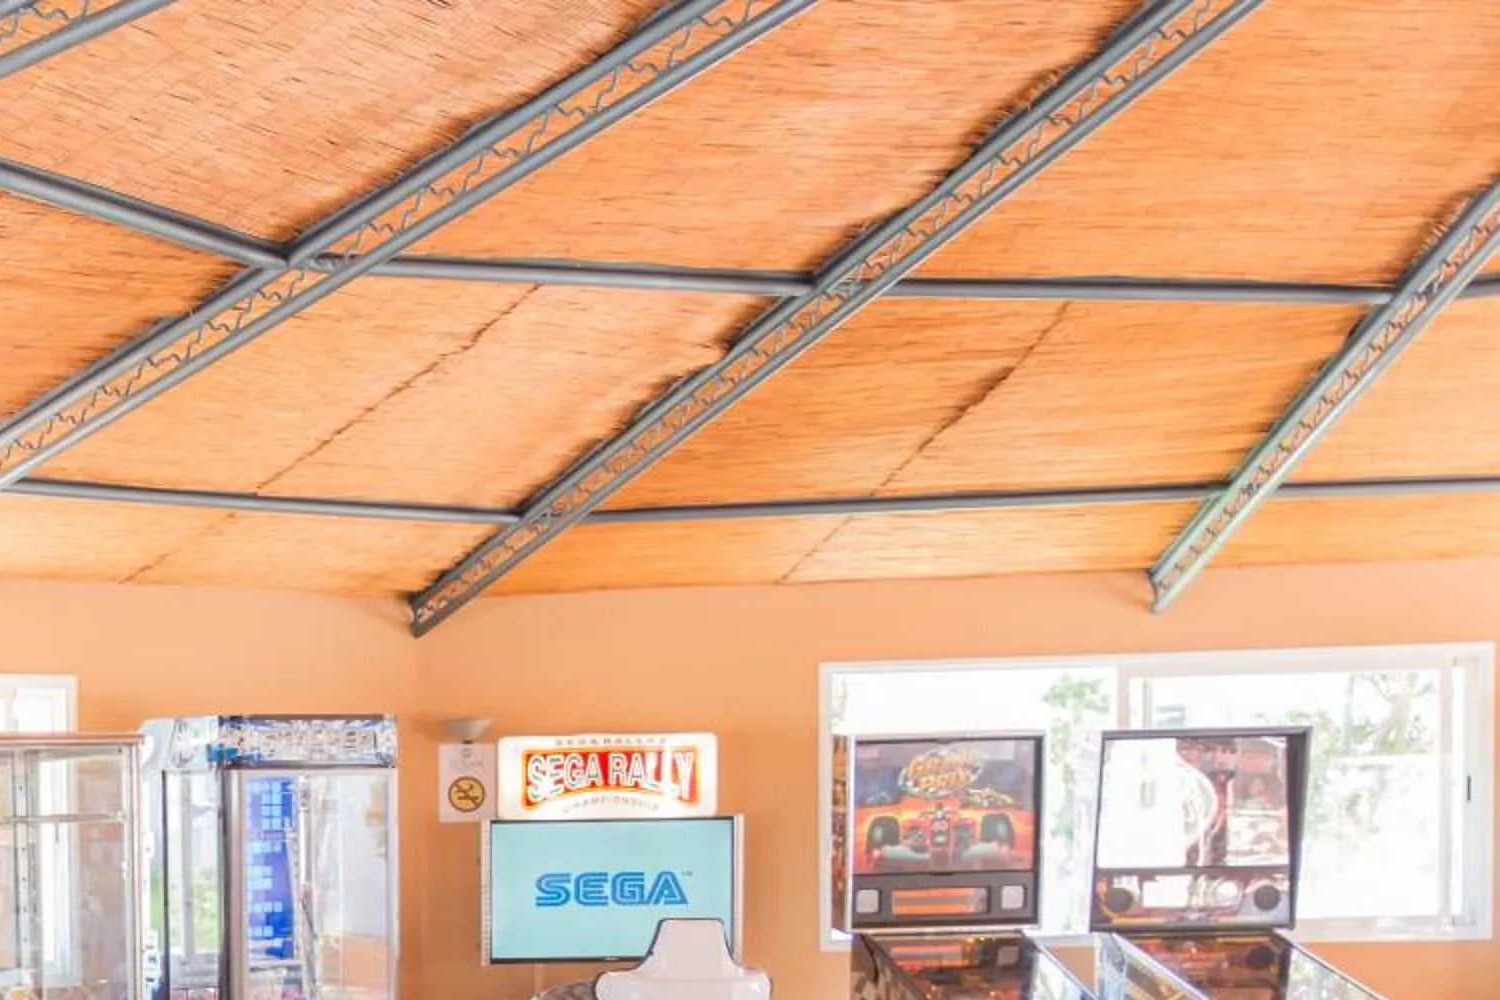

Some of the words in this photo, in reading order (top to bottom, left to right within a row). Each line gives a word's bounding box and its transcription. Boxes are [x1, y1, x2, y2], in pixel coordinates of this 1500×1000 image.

[528, 753, 602, 802] SEGA
[607, 751, 696, 801] RALLY
[535, 871, 689, 907] SEGA
